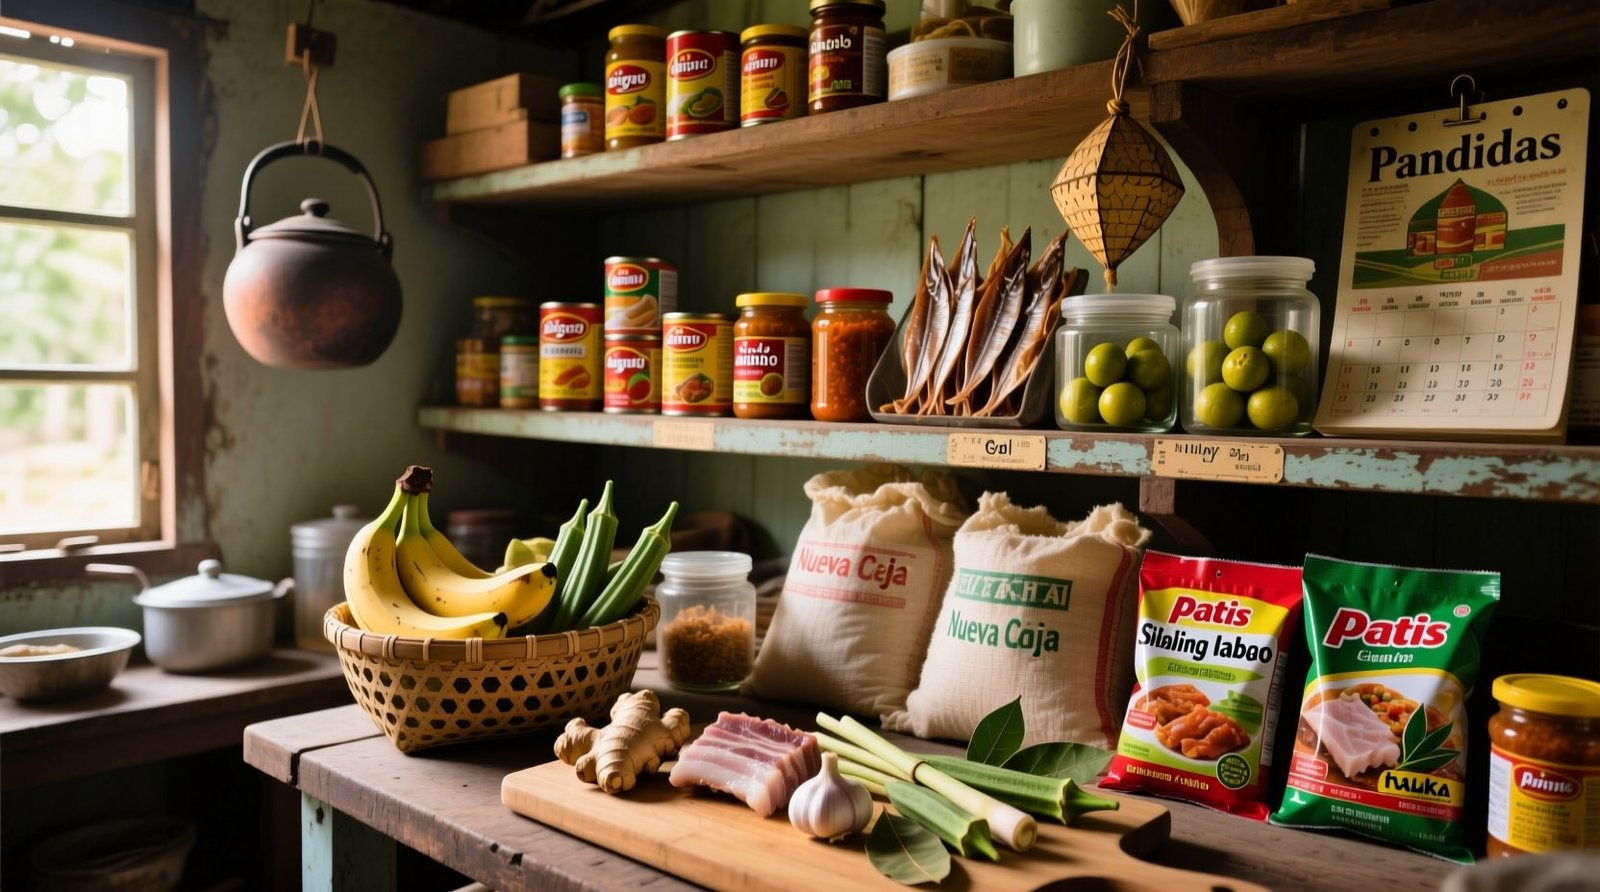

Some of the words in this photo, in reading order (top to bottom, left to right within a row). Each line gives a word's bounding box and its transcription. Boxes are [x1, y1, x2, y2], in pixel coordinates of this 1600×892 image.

[1369, 128, 1562, 183] Pandidas
[796, 546, 851, 578] Nueva
[947, 608, 999, 647] Nueva
[1167, 595, 1252, 628] Patis
[1322, 607, 1451, 649] Patis
